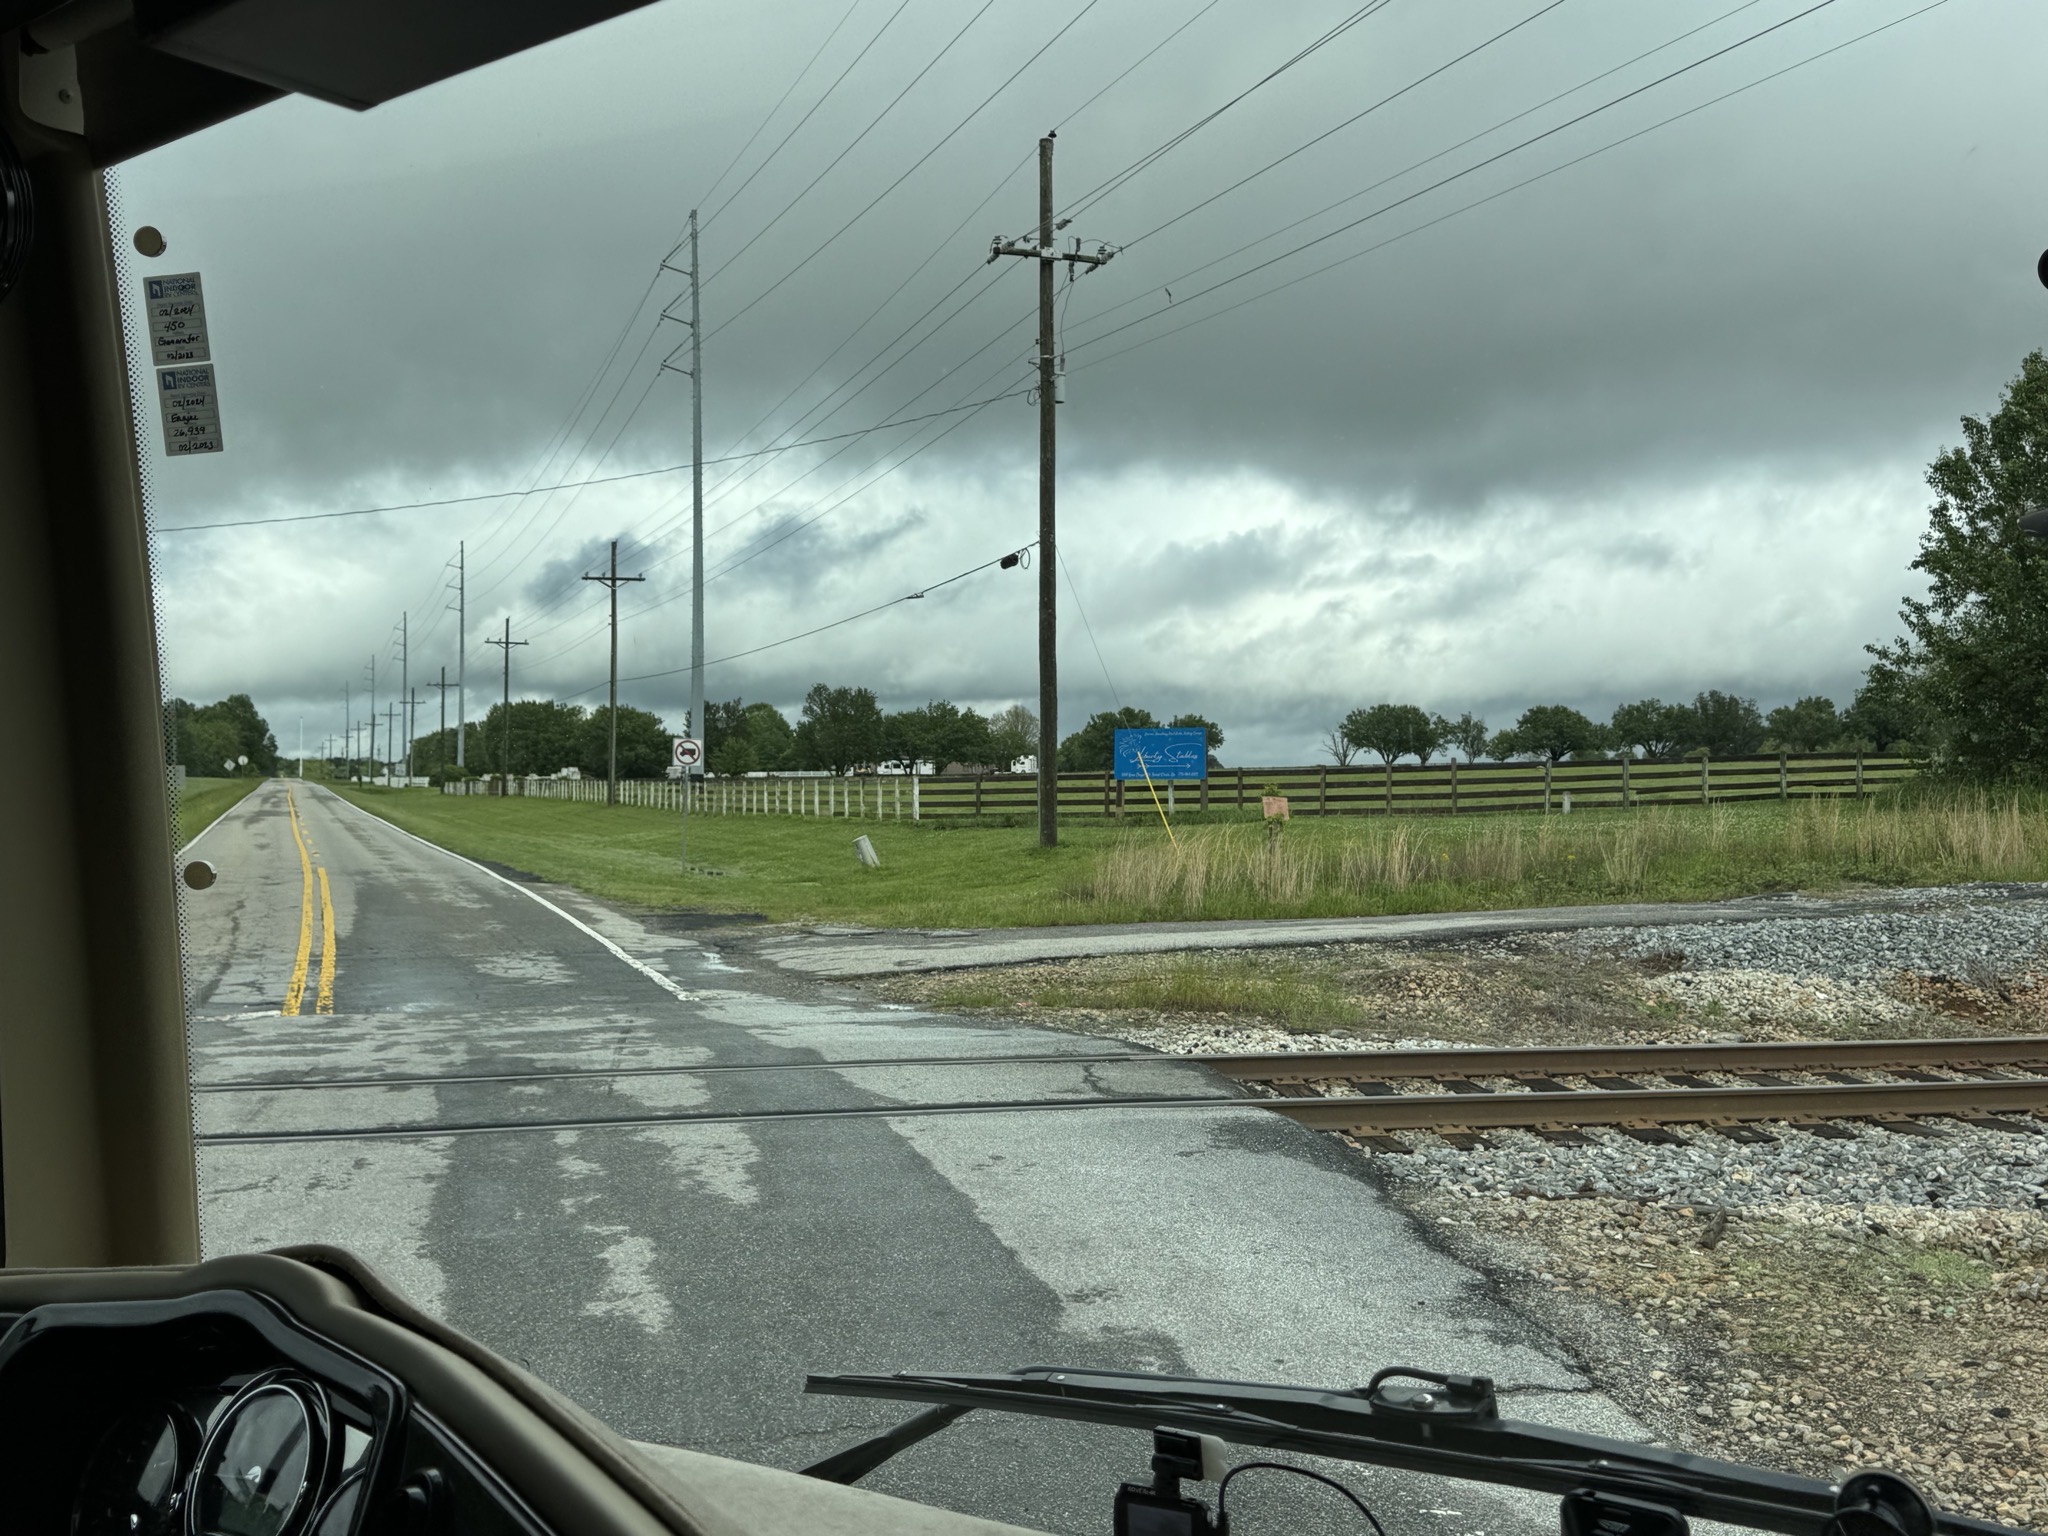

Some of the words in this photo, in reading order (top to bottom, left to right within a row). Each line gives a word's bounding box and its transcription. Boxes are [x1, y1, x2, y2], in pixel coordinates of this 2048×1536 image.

[163, 277, 195, 285] NATIONAL
[163, 284, 196, 292] INDOOR
[159, 304, 194, 317] 02/2024
[164, 321, 185, 332] 450
[176, 368, 209, 376] NATIONAL
[177, 375, 210, 383] INDOOR
[172, 396, 205, 410] 02/2024
[179, 441, 213, 454] 02/2023
[1165, 743, 1202, 763] Stables
